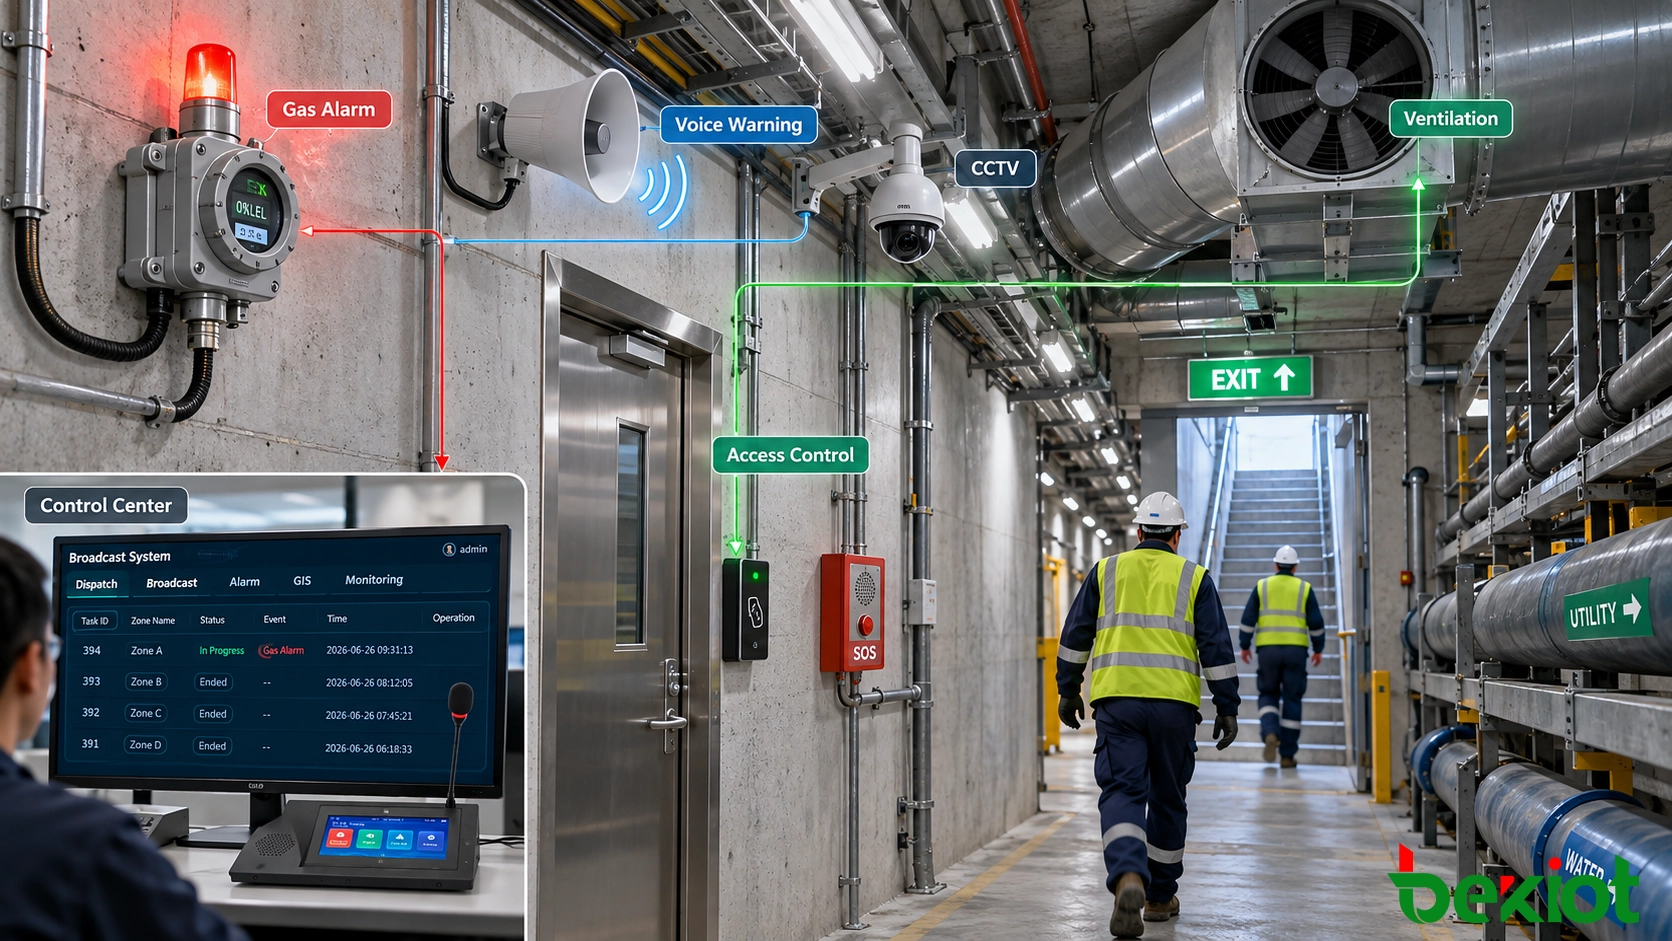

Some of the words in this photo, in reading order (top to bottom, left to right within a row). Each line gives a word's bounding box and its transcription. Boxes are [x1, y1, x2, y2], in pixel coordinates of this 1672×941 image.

[1211, 368, 1262, 391] EXIT
[459, 544, 488, 554] admin
[68, 551, 126, 563] Broadcast
[128, 550, 171, 565] System
[75, 578, 118, 592] Dispatch
[146, 577, 198, 588] Broadcast
[229, 576, 261, 587] Alarm
[293, 575, 312, 586] GIS
[345, 574, 404, 587] Monitoring
[263, 615, 287, 624] Event
[327, 614, 348, 624] Time
[432, 613, 475, 624] Operation
[1569, 601, 1617, 628] UTILITY
[81, 616, 99, 626] Task
[100, 616, 109, 626] ID
[131, 616, 151, 626] Zone
[152, 616, 176, 626] Name
[200, 615, 226, 625] Status
[82, 645, 101, 656] 394
[131, 645, 154, 655] Zone
[155, 645, 163, 655] A
[199, 646, 208, 655] In
[209, 645, 245, 657] Progress
[263, 645, 278, 655] Gas
[279, 645, 305, 655] Alarm
[326, 645, 375, 655] 2026-06-26
[377, 645, 414, 655] 09:31:13
[853, 645, 877, 661] SOS
[82, 676, 101, 686] 393
[130, 677, 153, 687] Zone
[155, 677, 162, 687] B
[199, 677, 228, 687] Ended
[326, 678, 375, 688] 2026-06-26
[376, 678, 413, 688] 08:12:05
[82, 707, 100, 718] 392
[130, 708, 153, 718] Zone
[155, 708, 162, 718] C
[199, 709, 227, 719] Ended
[325, 710, 375, 720] 2026-06-26
[376, 711, 413, 721] 07:45:21
[81, 739, 99, 749] 391
[129, 740, 152, 749] Zone
[155, 740, 162, 750] D
[199, 741, 226, 750] Ended
[325, 743, 375, 753] 2026-06-26
[376, 744, 413, 754] 06:18:33
